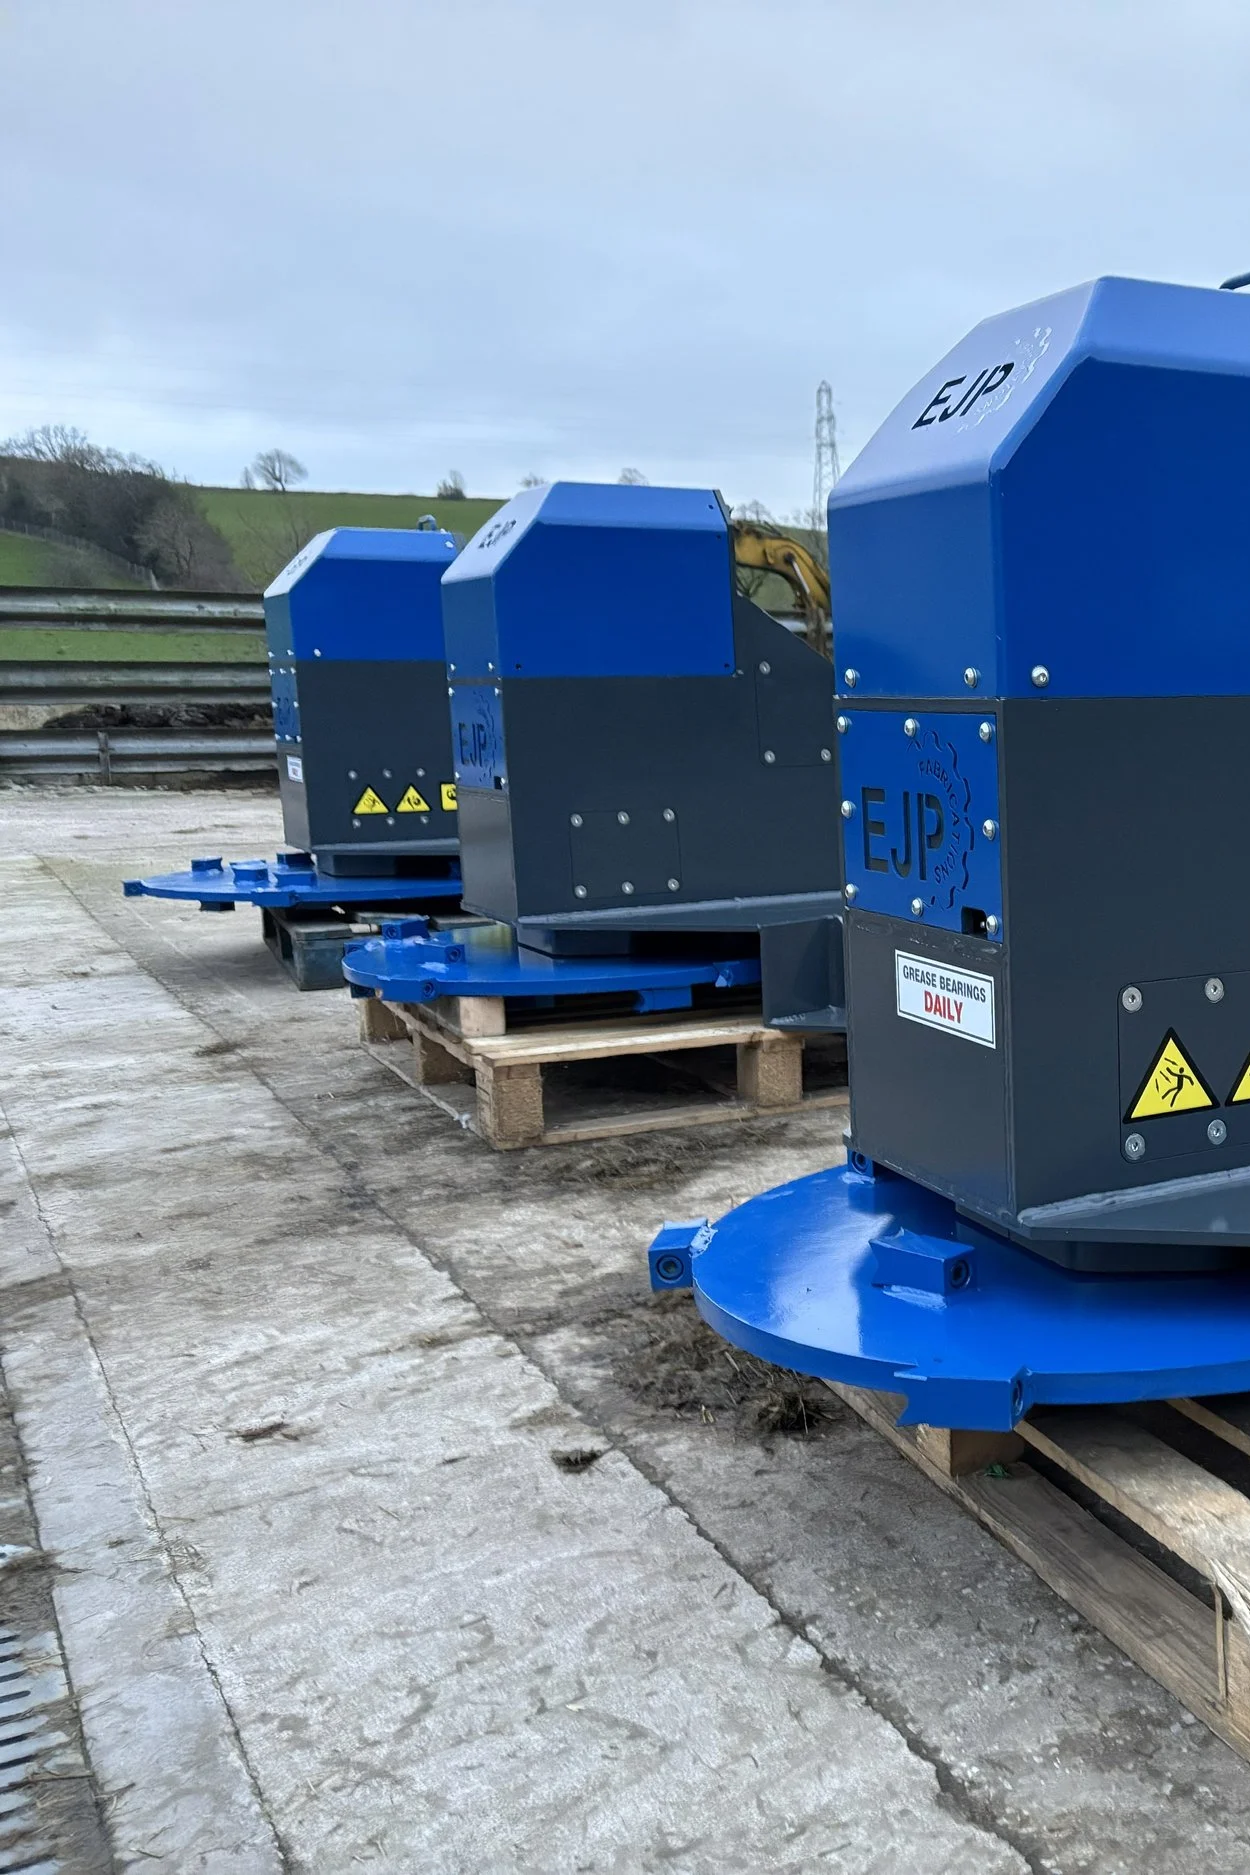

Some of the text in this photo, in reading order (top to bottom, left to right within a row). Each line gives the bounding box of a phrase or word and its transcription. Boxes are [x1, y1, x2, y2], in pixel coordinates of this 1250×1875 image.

[911, 362, 1014, 430] EJP
[458, 722, 487, 767] EJP
[861, 786, 944, 881] EJP
[918, 759, 960, 884] FABRICATIONS
[903, 965, 986, 1003] GREASE BEARINGS
[924, 990, 963, 1024] DAILY
